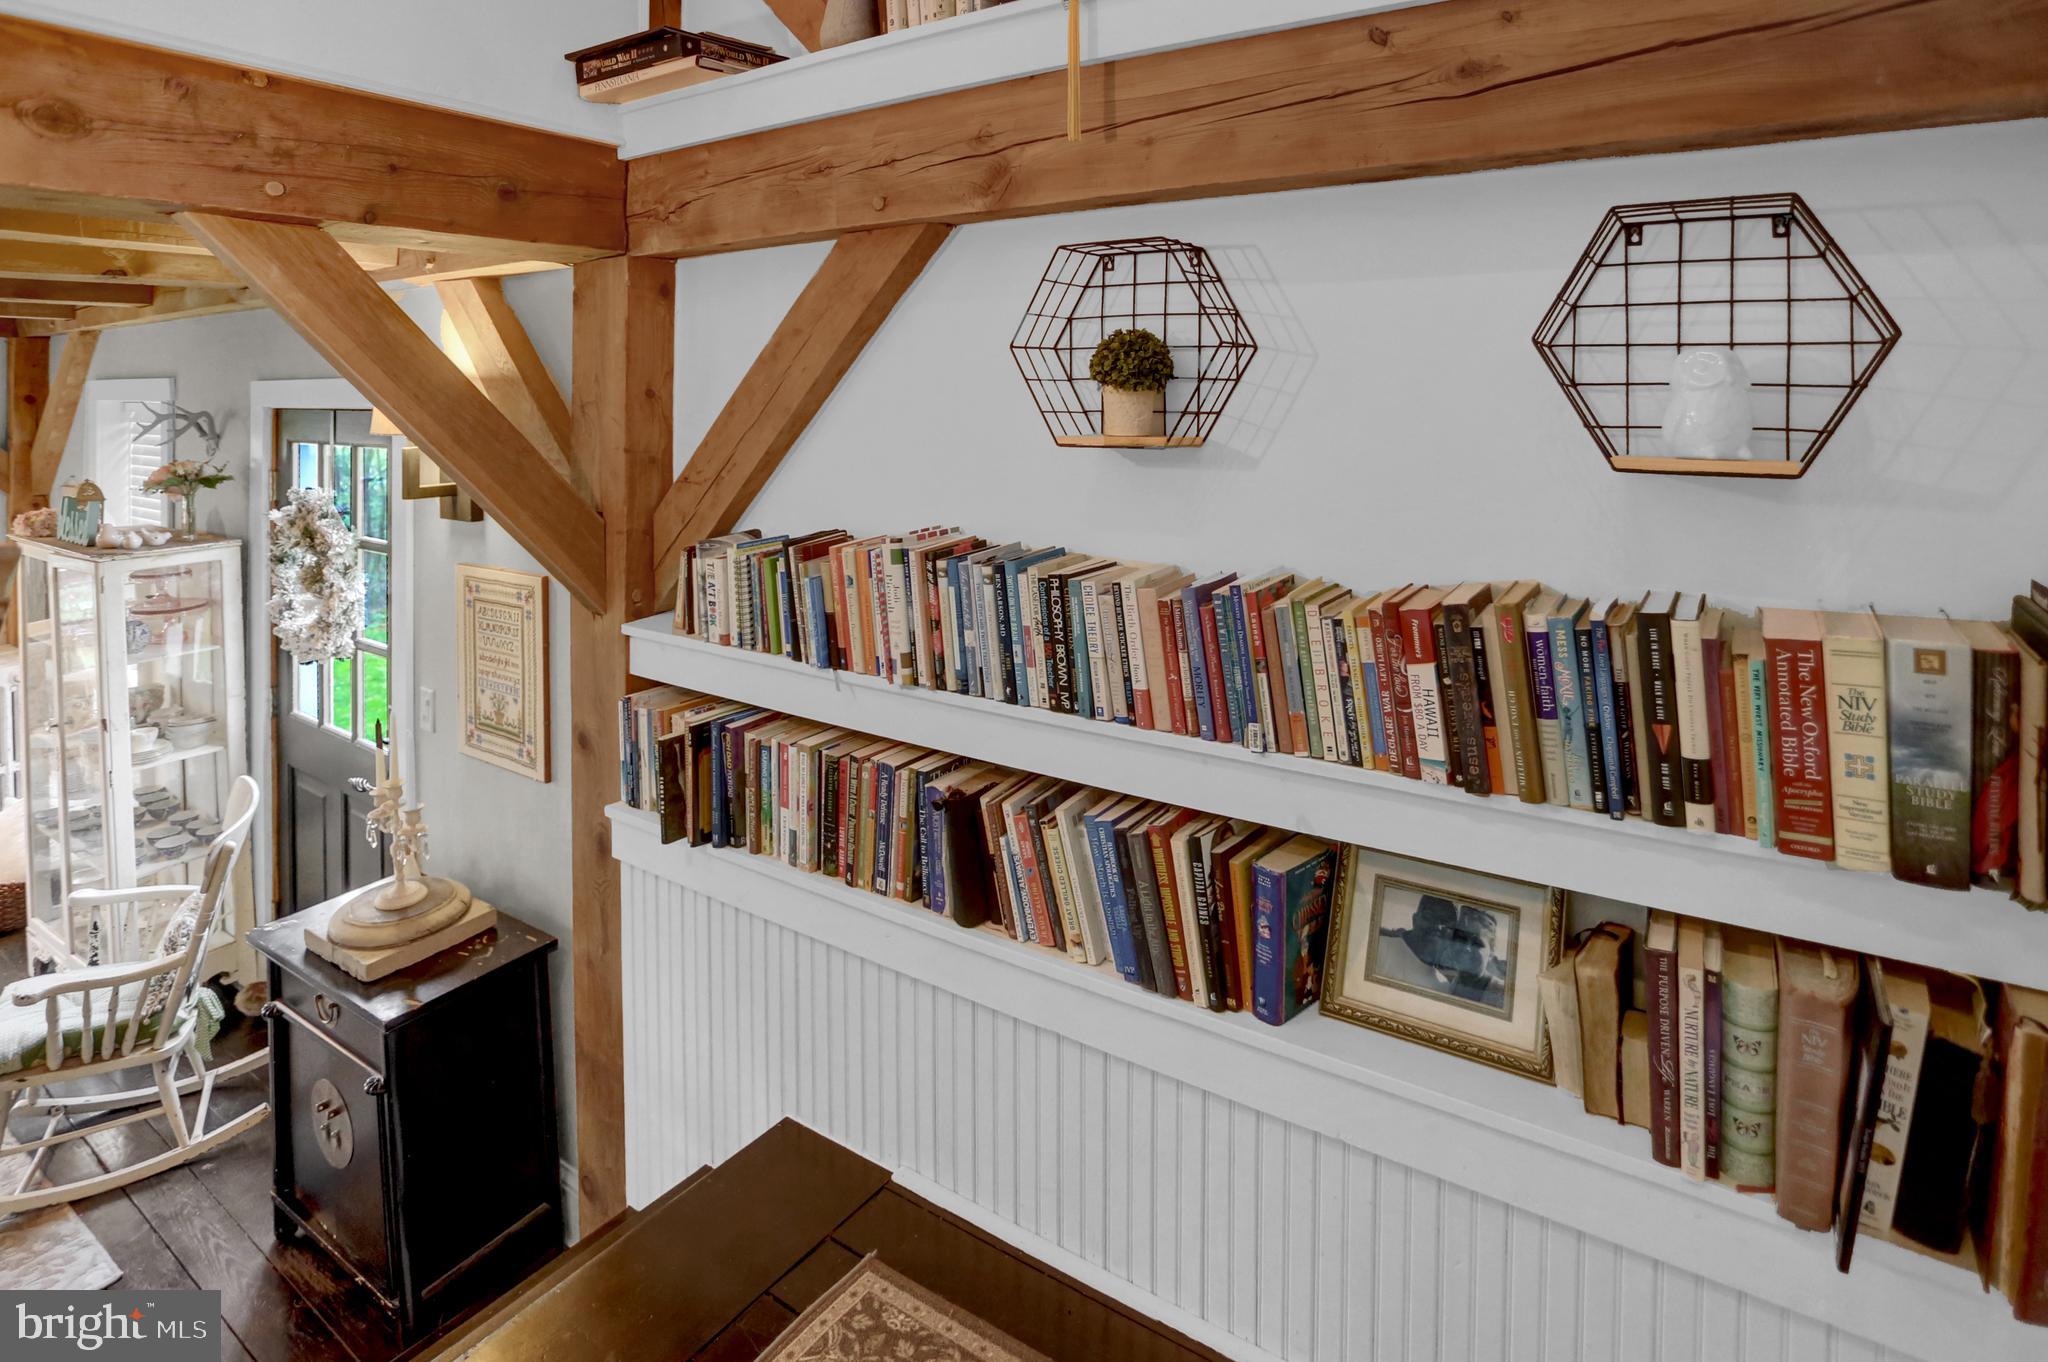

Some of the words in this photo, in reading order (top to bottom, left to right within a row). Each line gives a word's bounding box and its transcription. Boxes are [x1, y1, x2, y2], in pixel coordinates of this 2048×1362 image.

[617, 52, 631, 62] WAR
[632, 49, 637, 58] II
[719, 48, 745, 60] WORLD
[746, 54, 761, 65] WAR
[763, 57, 769, 66] II
[706, 563, 716, 579] THE
[892, 585, 901, 603] Jodi
[1006, 575, 1014, 597] SWITCH
[1112, 585, 1120, 607] BEYOND
[1123, 585, 1132, 601] The
[996, 590, 1004, 622] CARSON,
[1038, 581, 1048, 626] Confessions
[1050, 578, 1063, 641] PHILOSOPHY
[1083, 585, 1096, 616] CHOICE
[1115, 607, 1123, 631] BUMPER
[1125, 603, 1135, 630] Birth
[1174, 607, 1182, 628] Mitch
[999, 624, 1006, 637] MD
[1042, 627, 1050, 635] of
[1086, 622, 1098, 654] THEORY
[1176, 628, 1185, 649] Albom
[1250, 612, 1261, 647] Launch
[1346, 625, 1354, 649] PARENTS
[1437, 628, 1445, 646] WAYNE
[1579, 635, 1588, 647] NO
[1595, 627, 1604, 639] The
[1648, 628, 1659, 642] LIVE
[1118, 632, 1126, 657] STICKER
[1128, 632, 1138, 662] Order
[1375, 637, 1385, 662] LUSKO
[1555, 629, 1568, 658] MESS
[1056, 644, 1068, 686] BROWN
[1121, 658, 1129, 677] ETHICS
[1377, 662, 1388, 681] LEVI
[1391, 658, 1402, 672] the
[1439, 647, 1448, 674] JACOBSEN
[1535, 639, 1549, 680] women
[1581, 650, 1590, 673] MORE
[1598, 653, 1607, 667] Love
[1651, 651, 1662, 670] GRACE
[1796, 649, 1815, 682] The
[1045, 659, 1054, 688] Teacher
[1132, 663, 1141, 685] Book
[1306, 610, 1323, 646] DIE
[1316, 669, 1333, 737] BROKE
[1349, 658, 1360, 690] TEENAGERS
[1392, 672, 1408, 698] love
[1597, 667, 1609, 698] Languages
[1751, 669, 1761, 682] THE
[1191, 666, 1206, 708] MORLEY
[1410, 674, 1423, 699] FROM
[1539, 685, 1554, 712] faith
[1584, 676, 1593, 705] FAKING
[1653, 680, 1663, 696] WALK
[1752, 685, 1762, 701] VERY
[1775, 648, 1794, 731] Annotated
[1848, 688, 1865, 697] The
[1059, 692, 1070, 709] IVP
[1381, 690, 1392, 712] WAR
[1413, 702, 1424, 721] $80
[1507, 689, 1519, 726] ENOUGH
[1799, 684, 1817, 720] New
[1837, 695, 1878, 711] NIV
[1422, 688, 1439, 738] HAWAII
[1586, 708, 1596, 728] FINE
[1601, 705, 1612, 731] Children
[1654, 706, 1665, 721] LOVE
[1754, 704, 1763, 727] WORST
[1839, 709, 1876, 725] Study
[1385, 715, 1398, 762] DECLARE
[1842, 721, 1875, 734] Bible
[1418, 733, 1428, 752] DAY
[1589, 733, 1598, 760] ESTHER
[1605, 736, 1615, 764] Chapman
[1755, 729, 1765, 773] MISSIONARY
[1800, 721, 1821, 781] Oxford
[1464, 736, 1480, 785] Jesus
[1516, 750, 1527, 786] MILLION
[1780, 737, 1798, 777] Bible
[881, 772, 888, 780] A
[1692, 763, 1700, 778] BETH
[850, 779, 858, 794] WITH
[880, 779, 888, 799] Ready
[1608, 770, 1619, 800] Campbell
[1661, 777, 1671, 790] GOFF
[1693, 781, 1701, 801] MOORE
[1782, 786, 1824, 798] Apocrypha
[1906, 785, 1955, 801] STUDY
[879, 799, 887, 825] Defense
[1911, 796, 1952, 810] BIBLE
[919, 808, 927, 825] The
[848, 817, 857, 842] FRANKLIN
[919, 827, 927, 844] Call
[878, 840, 887, 871] McDowell
[921, 845, 927, 854] to
[1052, 846, 1063, 874] CHEESE
[1790, 842, 1821, 854] OXFORD
[1012, 854, 1026, 889] ALWAYS
[1098, 827, 1108, 859] CHRISTIAN
[1104, 860, 1116, 898] APOLOGETICS
[1107, 842, 1116, 874] HANDBOOK
[1113, 874, 1119, 882] OF
[920, 856, 929, 894] Brilliance
[1192, 862, 1205, 894] CAPITAL
[1031, 882, 1044, 913] CALLING
[1058, 875, 1070, 905] GRILLED
[1141, 890, 1155, 911] Light
[1021, 889, 1036, 940] EVERYBODY,
[1065, 907, 1076, 931] GREAT
[1145, 913, 1155, 922] in
[1196, 896, 1209, 925] GAINES
[1038, 914, 1049, 938] JESUS
[1147, 923, 1159, 938] the
[1167, 928, 1179, 943] AND
[1170, 943, 1184, 967] STUPID
[1659, 957, 1668, 972] THE
[1658, 974, 1669, 1015] PURPOSE
[1659, 1018, 1670, 1056] DRIVEN
[1683, 1008, 1698, 1056] NURTURE
[1653, 1054, 1675, 1088] Life
[1706, 1049, 1716, 1095] LANGUAGES
[1684, 1070, 1698, 1110] NATURE
[1663, 1089, 1671, 1121] WARREN
[1707, 1097, 1716, 1117] LOVE
